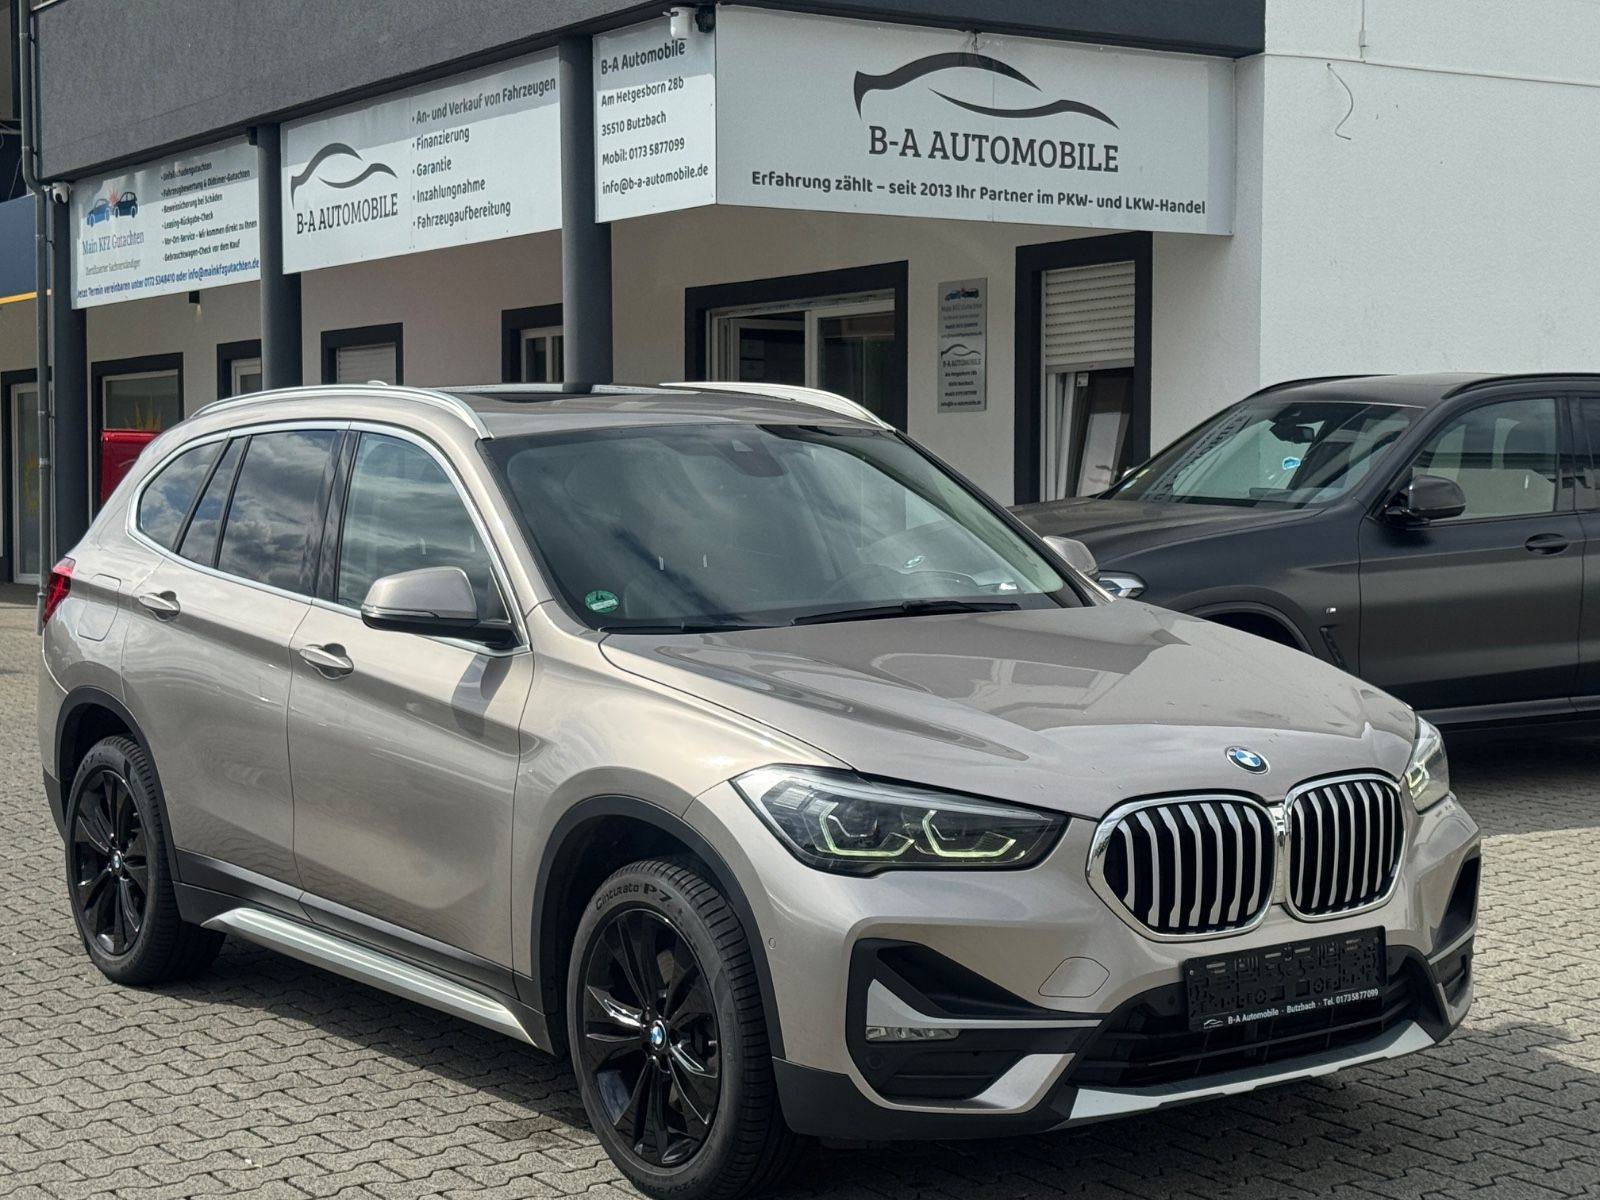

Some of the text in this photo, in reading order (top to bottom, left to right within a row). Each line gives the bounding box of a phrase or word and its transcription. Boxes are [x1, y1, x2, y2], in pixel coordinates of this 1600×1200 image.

[601, 39, 685, 75] B-A Automobile
[416, 77, 556, 124] An- und Verkauf von Fahrzeugen
[602, 77, 683, 106] Am Hetgesborn 28b
[602, 111, 666, 136] 35510 Butzbach
[416, 127, 469, 150] Finanzierung
[602, 138, 684, 165] Mobil: 0173 5877099
[869, 125, 1119, 172] B-A AUTOMOBILE
[416, 157, 451, 176] Garantie
[603, 163, 708, 195] info@b-a-automobile.de
[205, 193, 222, 205] Schäden
[417, 178, 485, 200] Inzahlungnahme
[752, 171, 831, 192] Erfahrung
[835, 174, 873, 192] zählt
[889, 180, 916, 195] seit
[920, 183, 952, 198] 2013
[956, 185, 975, 199] Ihr
[980, 186, 1033, 204] Partner
[1038, 188, 1054, 204] im
[1058, 192, 1093, 207] PKW-
[1097, 195, 1122, 210] und
[1126, 196, 1206, 214] LKW-Handel
[297, 193, 398, 234] B-A AUTOMOBILE
[417, 201, 510, 229] Fahrzeugaufbereitung
[207, 228, 224, 236] kommen
[225, 224, 237, 233] direkt
[245, 220, 257, 229] Ihnen
[83, 230, 144, 255] Main KFZ Gutachten
[230, 239, 240, 249] Kauf
[88, 287, 103, 296] Termin
[104, 282, 130, 293] vereinbaren
[131, 280, 144, 289] unter
[176, 271, 187, 282] oder
[188, 258, 259, 281] info@mainkfzgutachten.de
[643, 883, 672, 902] P7
[1228, 1015, 1241, 1024] B-A
[1242, 1009, 1278, 1022] Automobile
[1287, 1001, 1316, 1014] Butzbach
[1324, 998, 1333, 1006] Tel.
